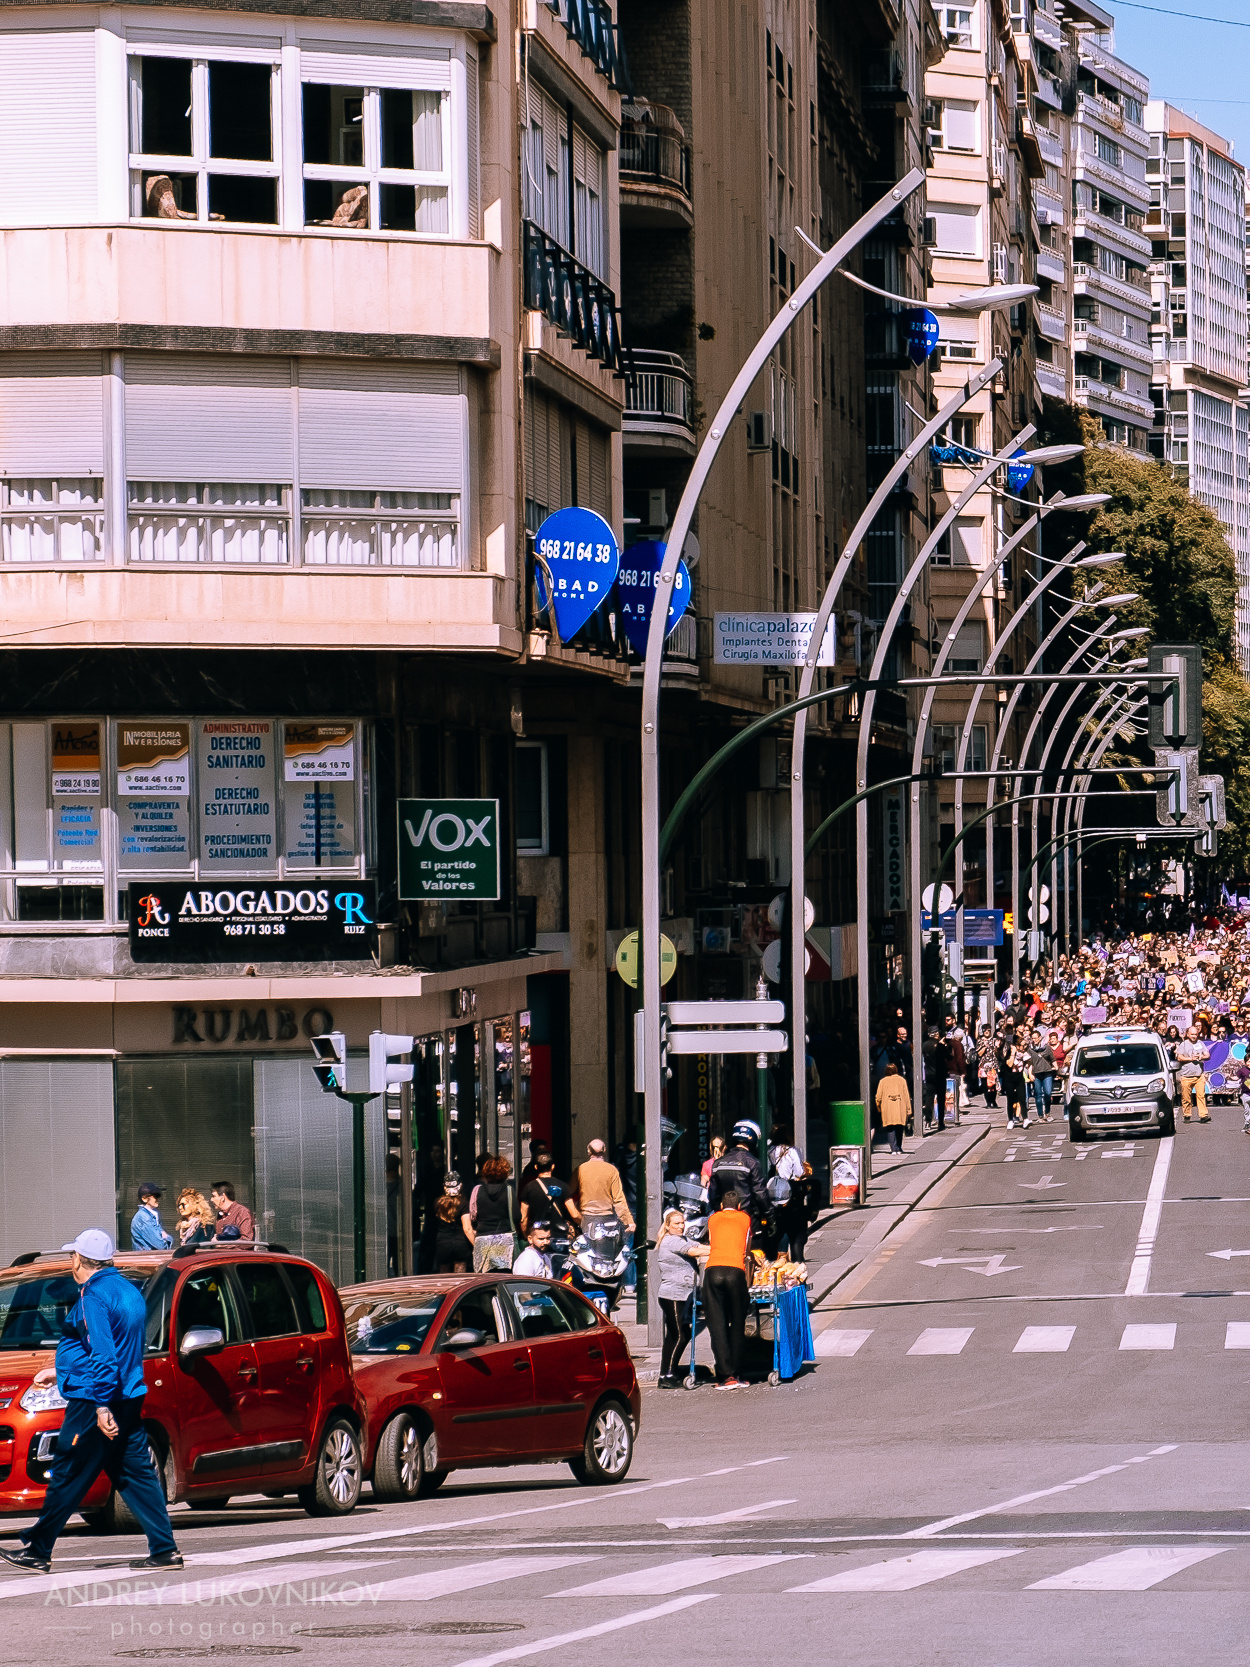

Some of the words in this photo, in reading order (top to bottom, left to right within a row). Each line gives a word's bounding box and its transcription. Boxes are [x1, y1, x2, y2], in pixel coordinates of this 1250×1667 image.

[540, 539, 560, 558] 968
[562, 541, 575, 560] 21
[576, 542, 592, 562] 64
[594, 543, 610, 563] 38
[549, 577, 599, 593] BAD
[618, 569, 638, 586] 968
[639, 571, 650, 587] 21
[653, 570, 683, 589] 68
[722, 637, 773, 648] Implantes
[777, 637, 823, 648] Denta
[723, 649, 759, 661] Cirugía
[762, 650, 824, 660] Maxilofal
[203, 723, 269, 733] ADMINISTRATIVO
[210, 736, 261, 751] DERECHO
[207, 755, 266, 769] SANITARIO
[341, 761, 351, 769] 70
[175, 775, 186, 783] 70
[214, 787, 259, 800] DERECHO
[204, 803, 269, 815] ESTATUTARIO
[404, 809, 491, 852] VOX
[204, 834, 272, 846] PROCEDIMIENTO
[208, 848, 268, 858] SANCIONADOR
[886, 799, 901, 910] MERCADONA
[420, 861, 432, 869] El
[434, 860, 476, 871] partido
[422, 880, 475, 890] Valores
[178, 889, 329, 916] ABOGADOS
[138, 928, 170, 937] PONCE
[223, 925, 243, 936] 968
[244, 925, 256, 935] 71
[259, 925, 272, 935] 30
[273, 924, 286, 935] 58
[344, 926, 366, 935] RUIZ
[171, 1006, 334, 1043] RUMBO
[697, 1076, 707, 1111] ORO
